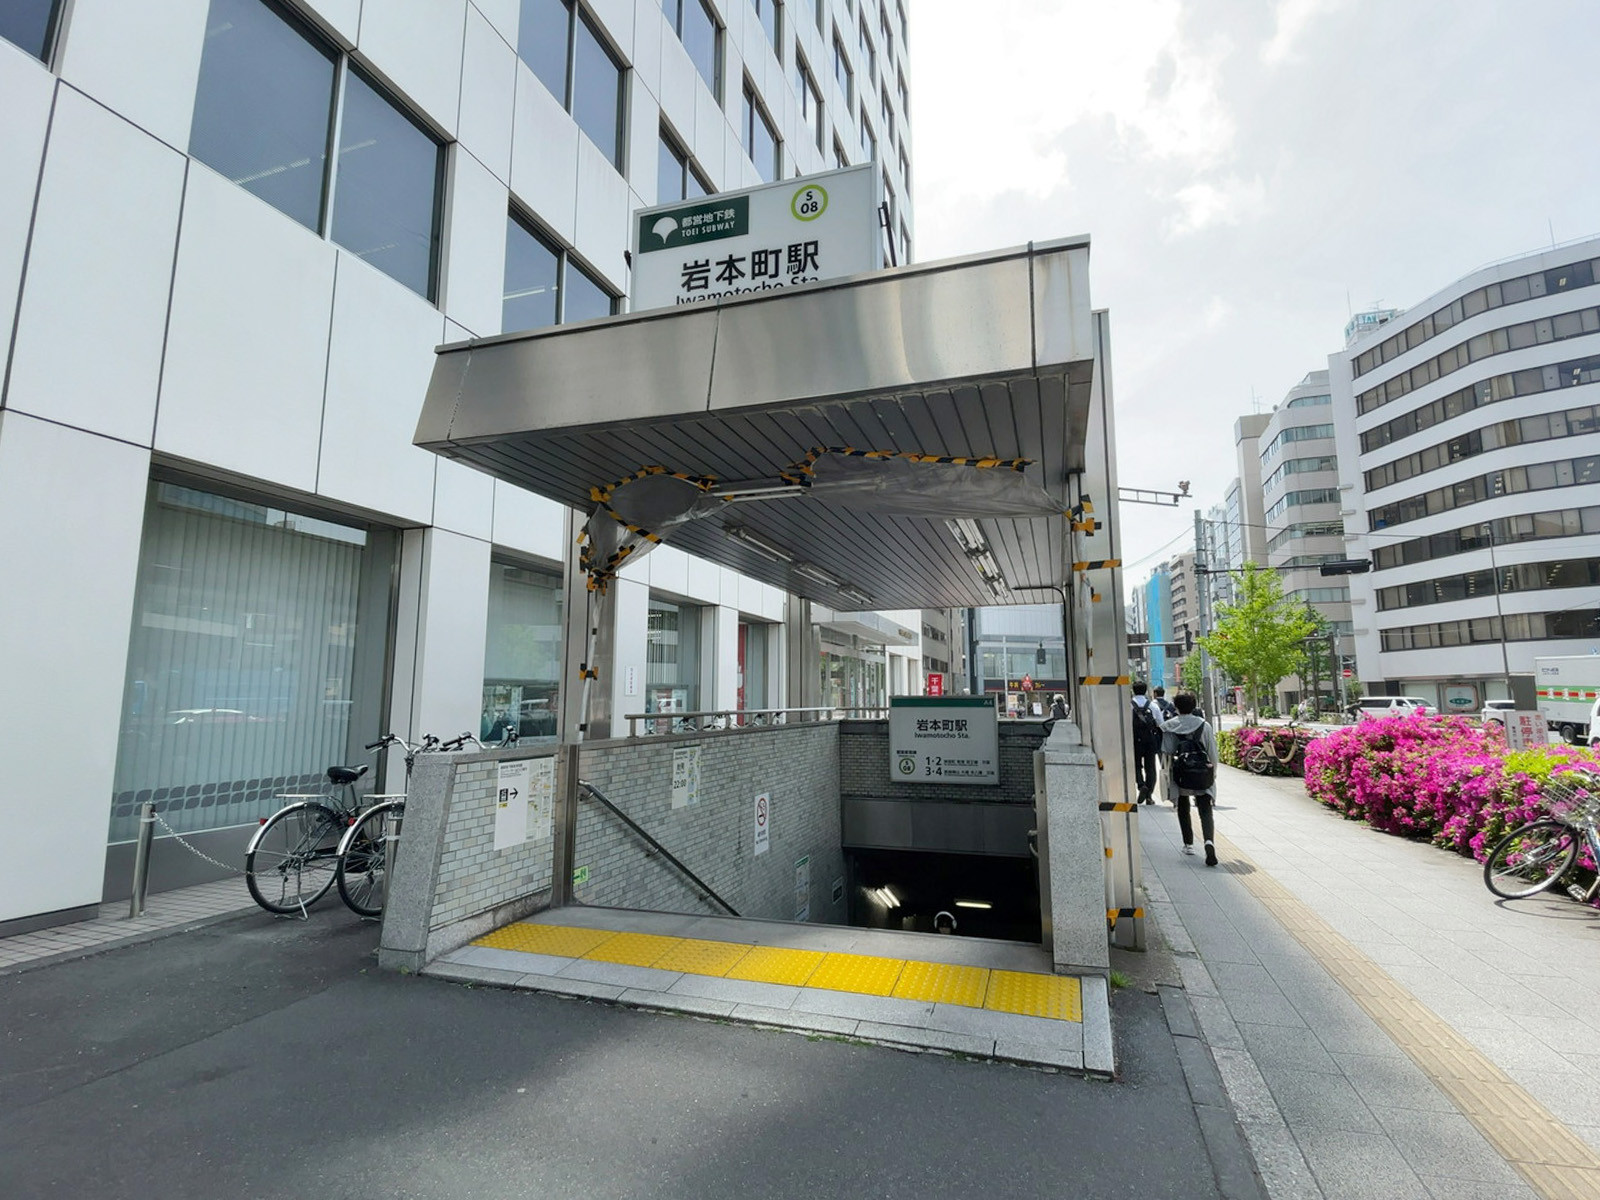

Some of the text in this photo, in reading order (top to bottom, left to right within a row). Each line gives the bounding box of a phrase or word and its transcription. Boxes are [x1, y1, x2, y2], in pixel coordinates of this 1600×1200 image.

[805, 190, 814, 201] S
[800, 201, 819, 214] 08
[682, 208, 736, 228] 都営地下鉄
[681, 220, 735, 237] TOEI SUBWAY
[680, 239, 820, 293] 岩本町駅
[916, 719, 968, 732] 岩本町駅
[914, 731, 956, 739] Iwamotocho
